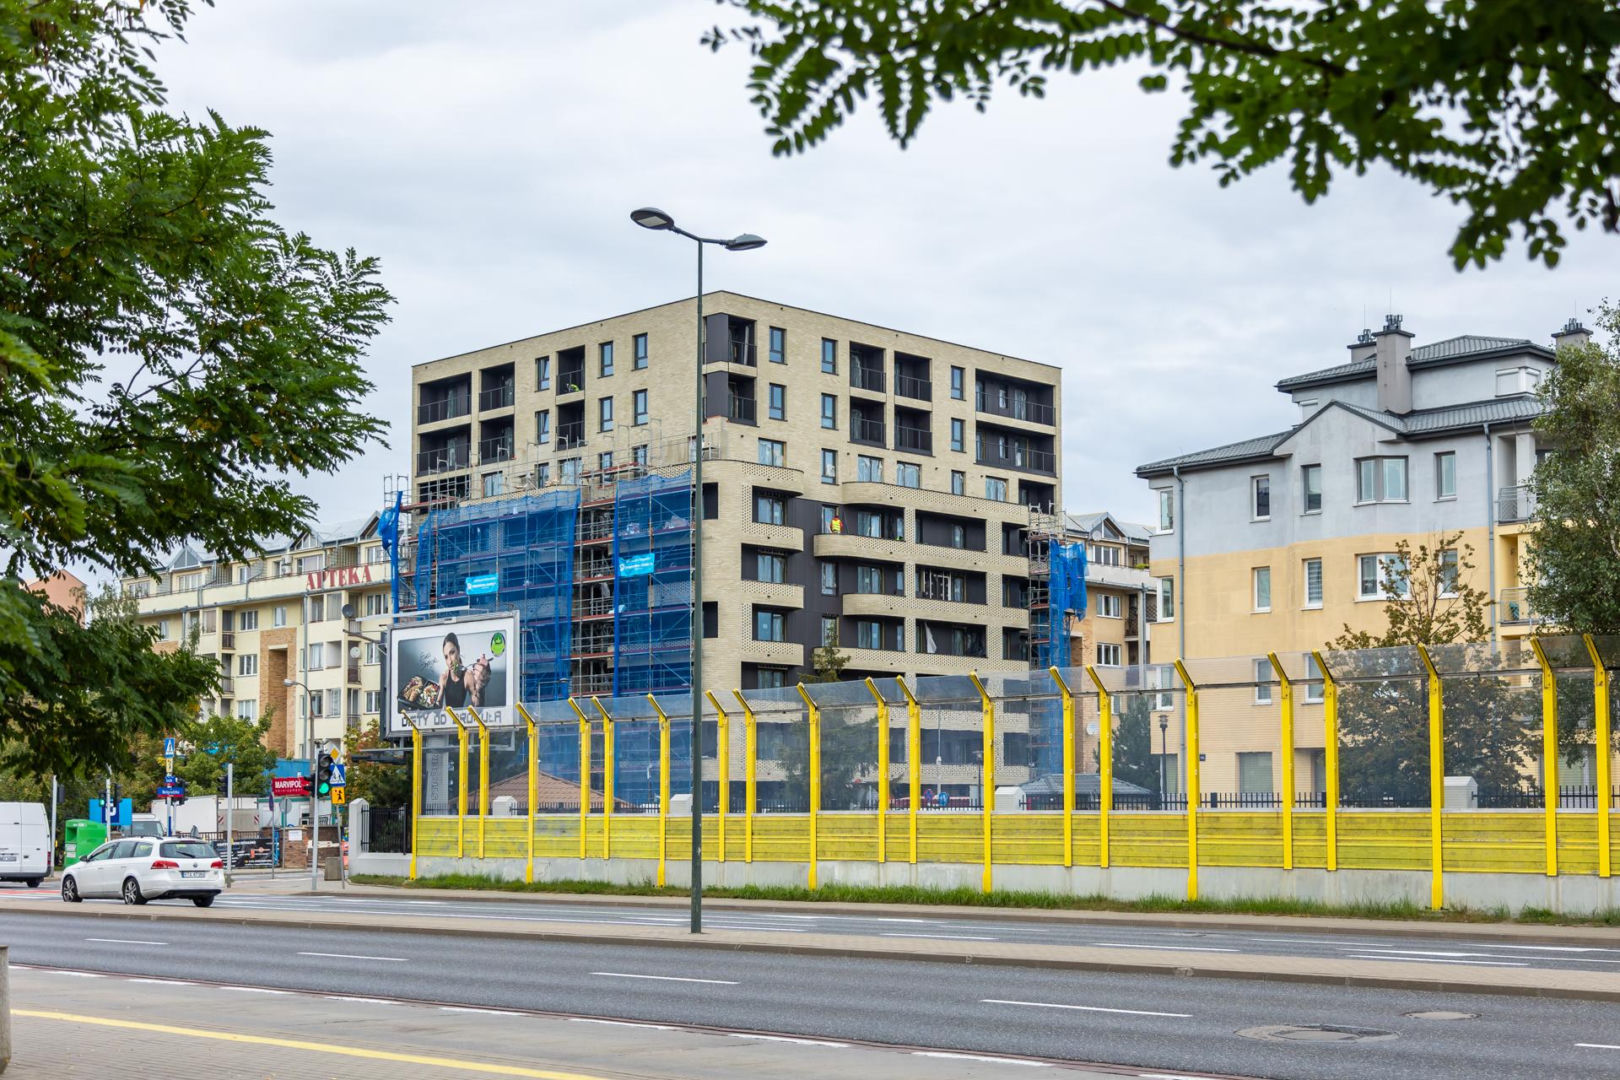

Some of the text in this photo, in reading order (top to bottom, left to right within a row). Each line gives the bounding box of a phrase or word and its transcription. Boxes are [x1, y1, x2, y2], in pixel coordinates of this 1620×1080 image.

[306, 564, 372, 590] APTEKA
[434, 713, 447, 725] OD
[274, 780, 302, 789] MARVIPOL
